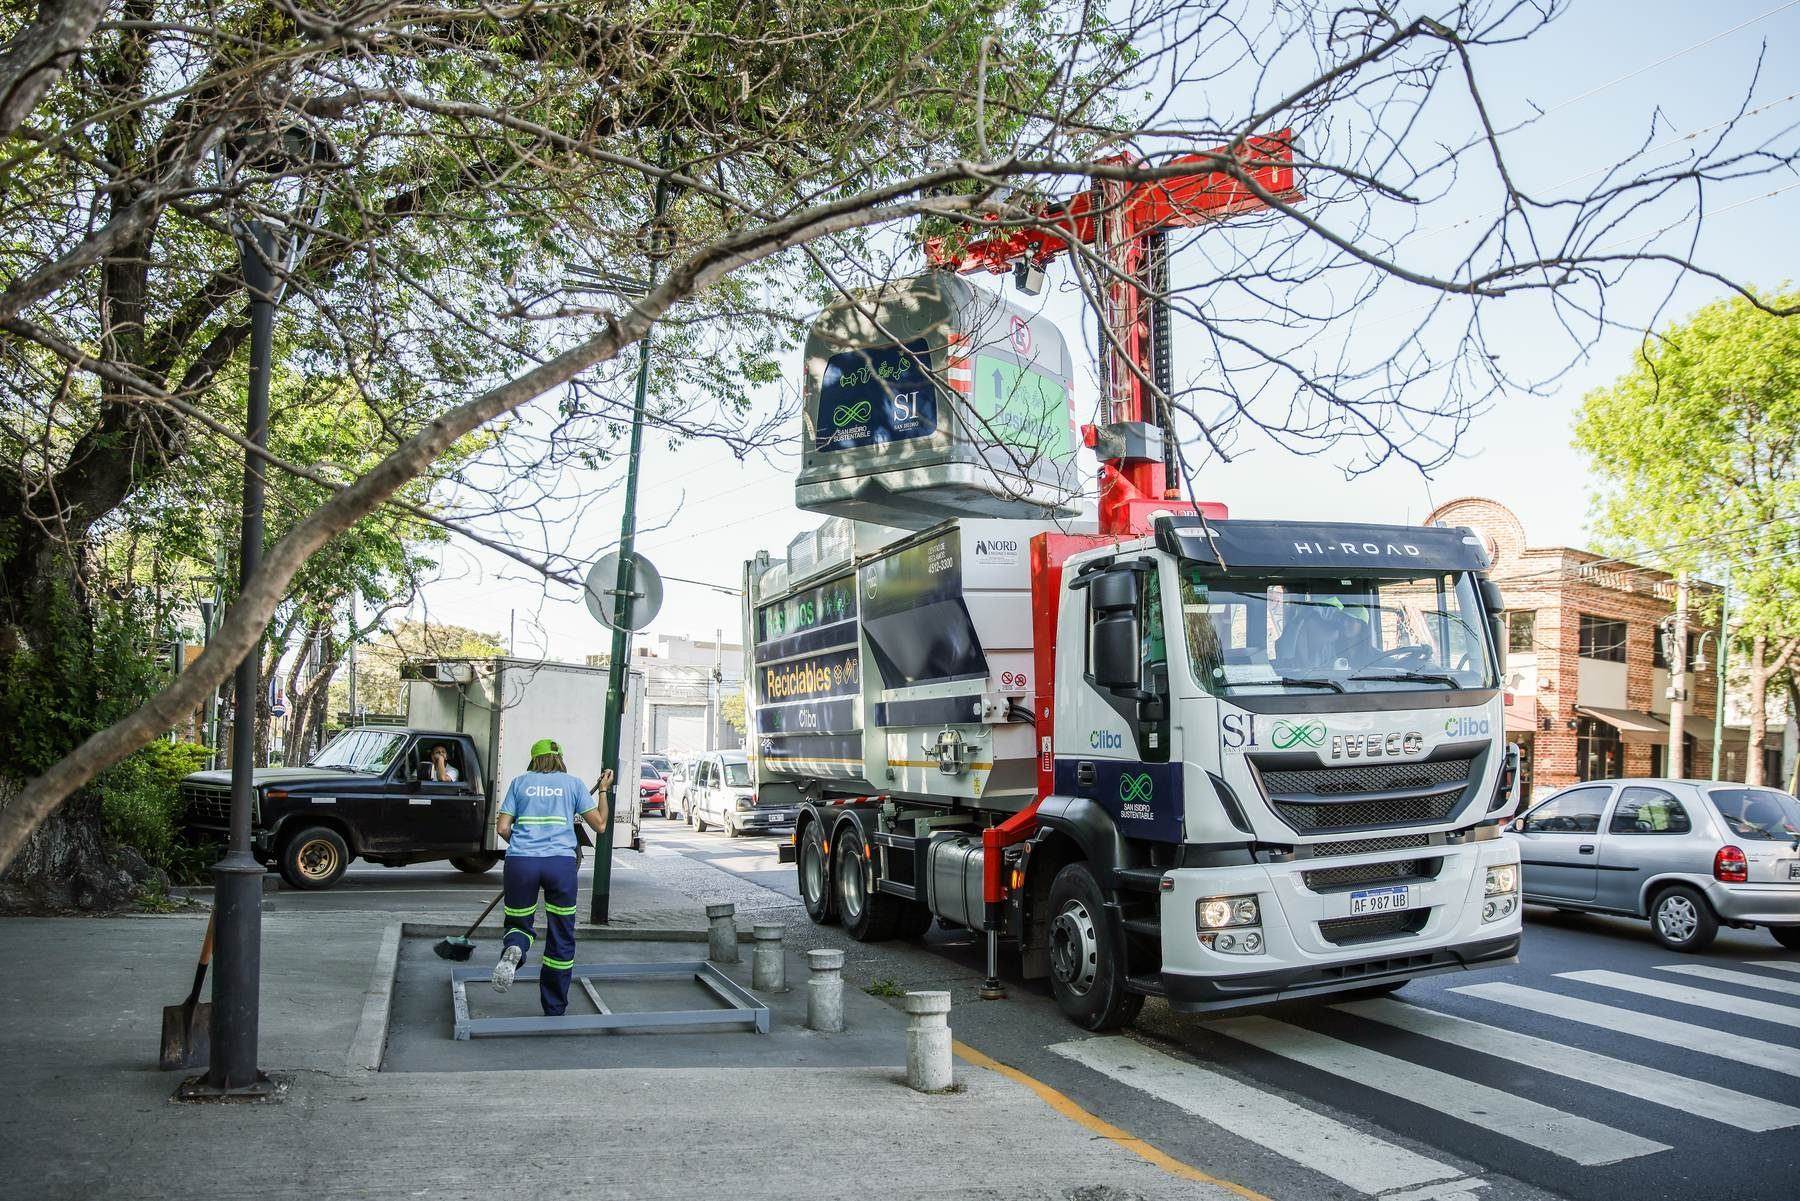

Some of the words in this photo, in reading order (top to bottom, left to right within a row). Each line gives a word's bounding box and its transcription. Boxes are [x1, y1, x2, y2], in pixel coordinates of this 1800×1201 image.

[893, 391, 919, 421] SI
[833, 430, 871, 442] SUSTENTABLE
[987, 540, 1017, 551] NORD
[1293, 542, 1420, 556] HI-ROAD
[766, 600, 815, 640] Resos
[767, 661, 832, 698] Reciclables
[799, 709, 817, 728] Cliba
[1444, 716, 1489, 737] Cliba
[1090, 730, 1122, 749] Cliba
[1222, 714, 1258, 747] SI
[1332, 732, 1423, 759] IVECO
[526, 786, 564, 797] Cliba
[1120, 811, 1154, 820] SUSTENTABLE
[1123, 803, 1133, 811] SAN
[1133, 804, 1151, 812] ISIDRO
[1354, 899, 1367, 912] AF
[1370, 896, 1389, 910] 987
[1392, 894, 1406, 907] UB
